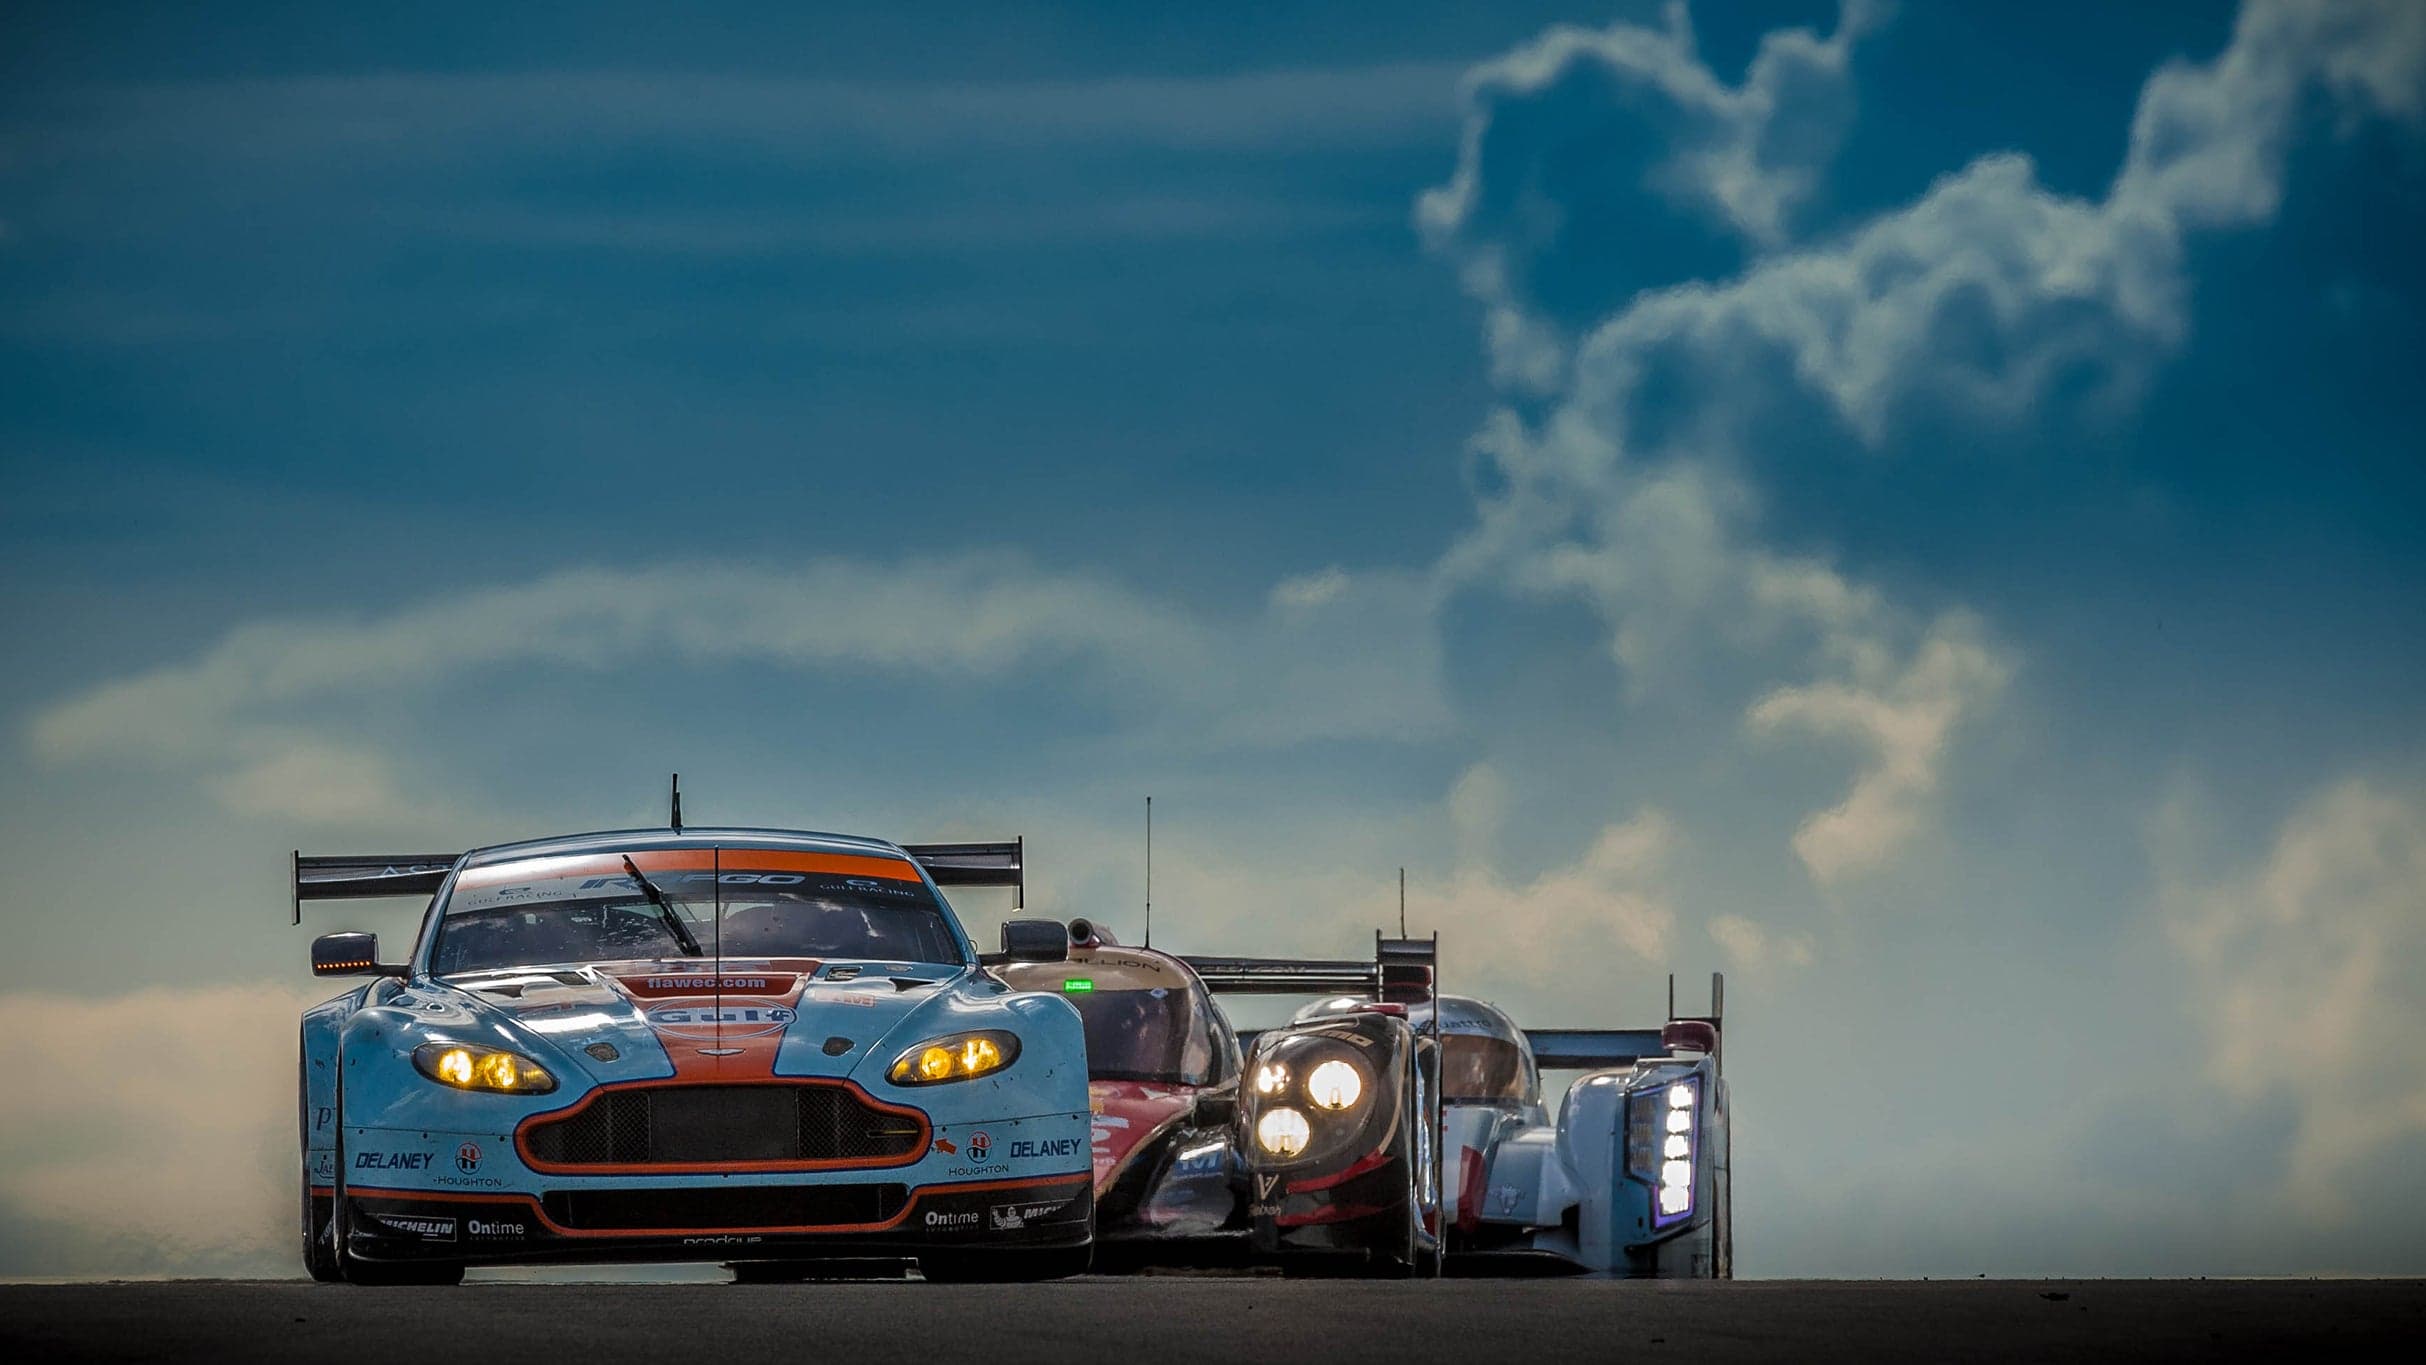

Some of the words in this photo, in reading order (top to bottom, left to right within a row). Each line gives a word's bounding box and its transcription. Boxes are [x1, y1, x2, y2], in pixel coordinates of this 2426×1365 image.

[648, 976, 766, 989] fiawec.com
[1010, 1138, 1082, 1159] DELANEY
[355, 1152, 434, 1170] DELANEY
[948, 1164, 1010, 1177] HOUGHTON
[437, 1175, 502, 1187] HOUGHTON
[925, 1210, 980, 1227] Ontime
[468, 1219, 525, 1236] Ontime
